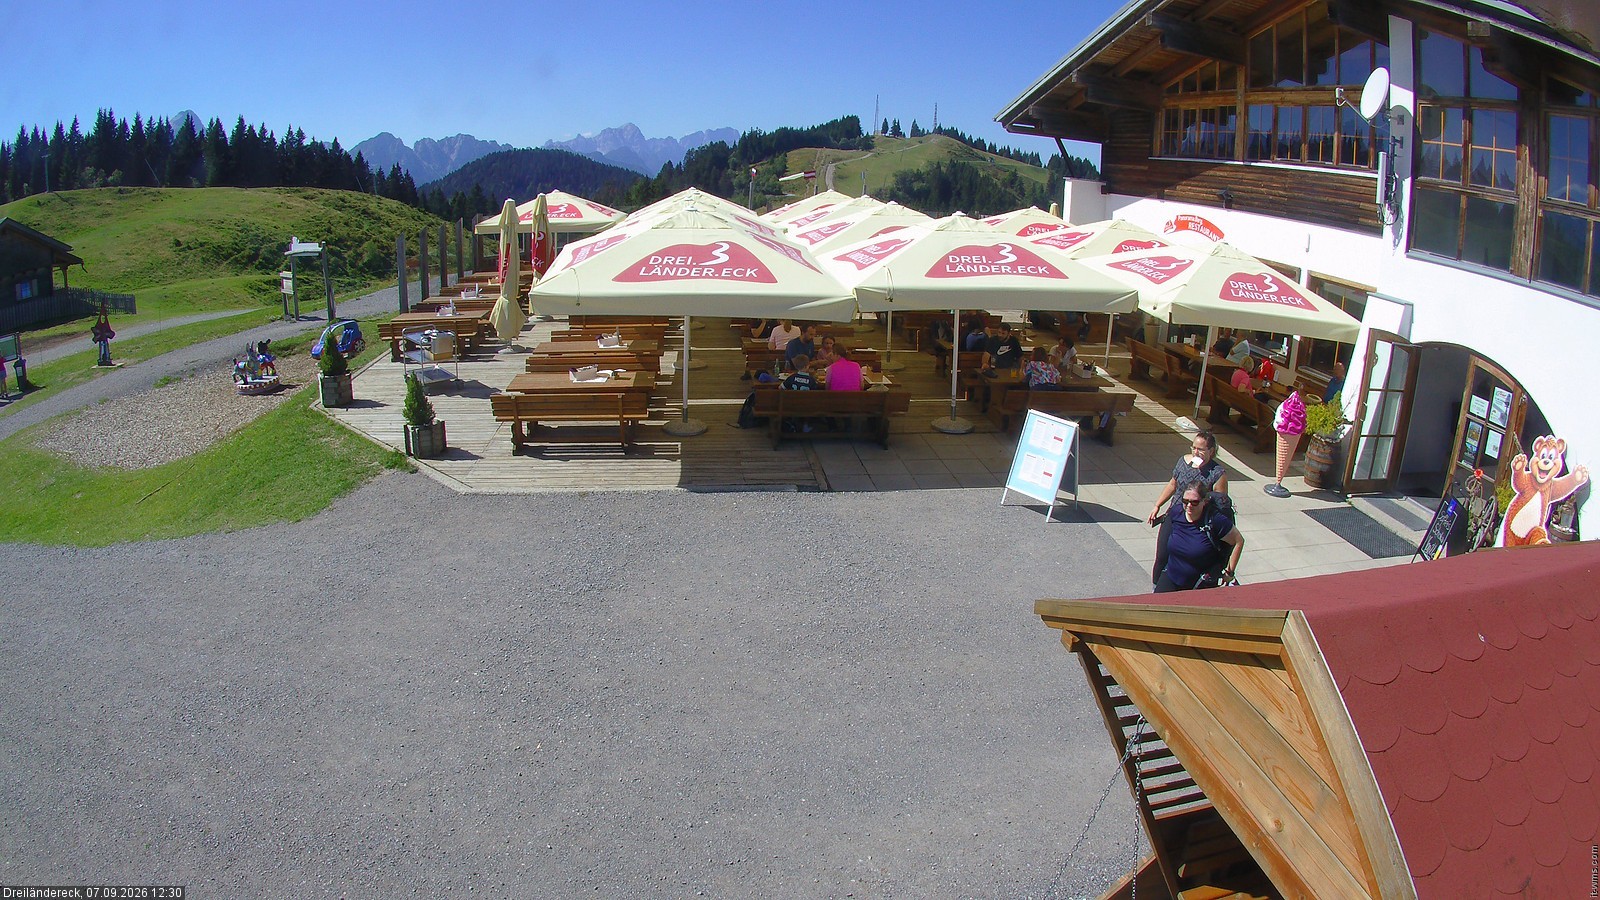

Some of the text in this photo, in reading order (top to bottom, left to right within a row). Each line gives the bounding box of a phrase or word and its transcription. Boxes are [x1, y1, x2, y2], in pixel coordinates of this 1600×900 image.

[639, 265, 759, 278] LÄNDER.ECK
[945, 263, 1050, 274] LÄNDER.ECK
[1230, 288, 1305, 306] LÄNDER.ECK
